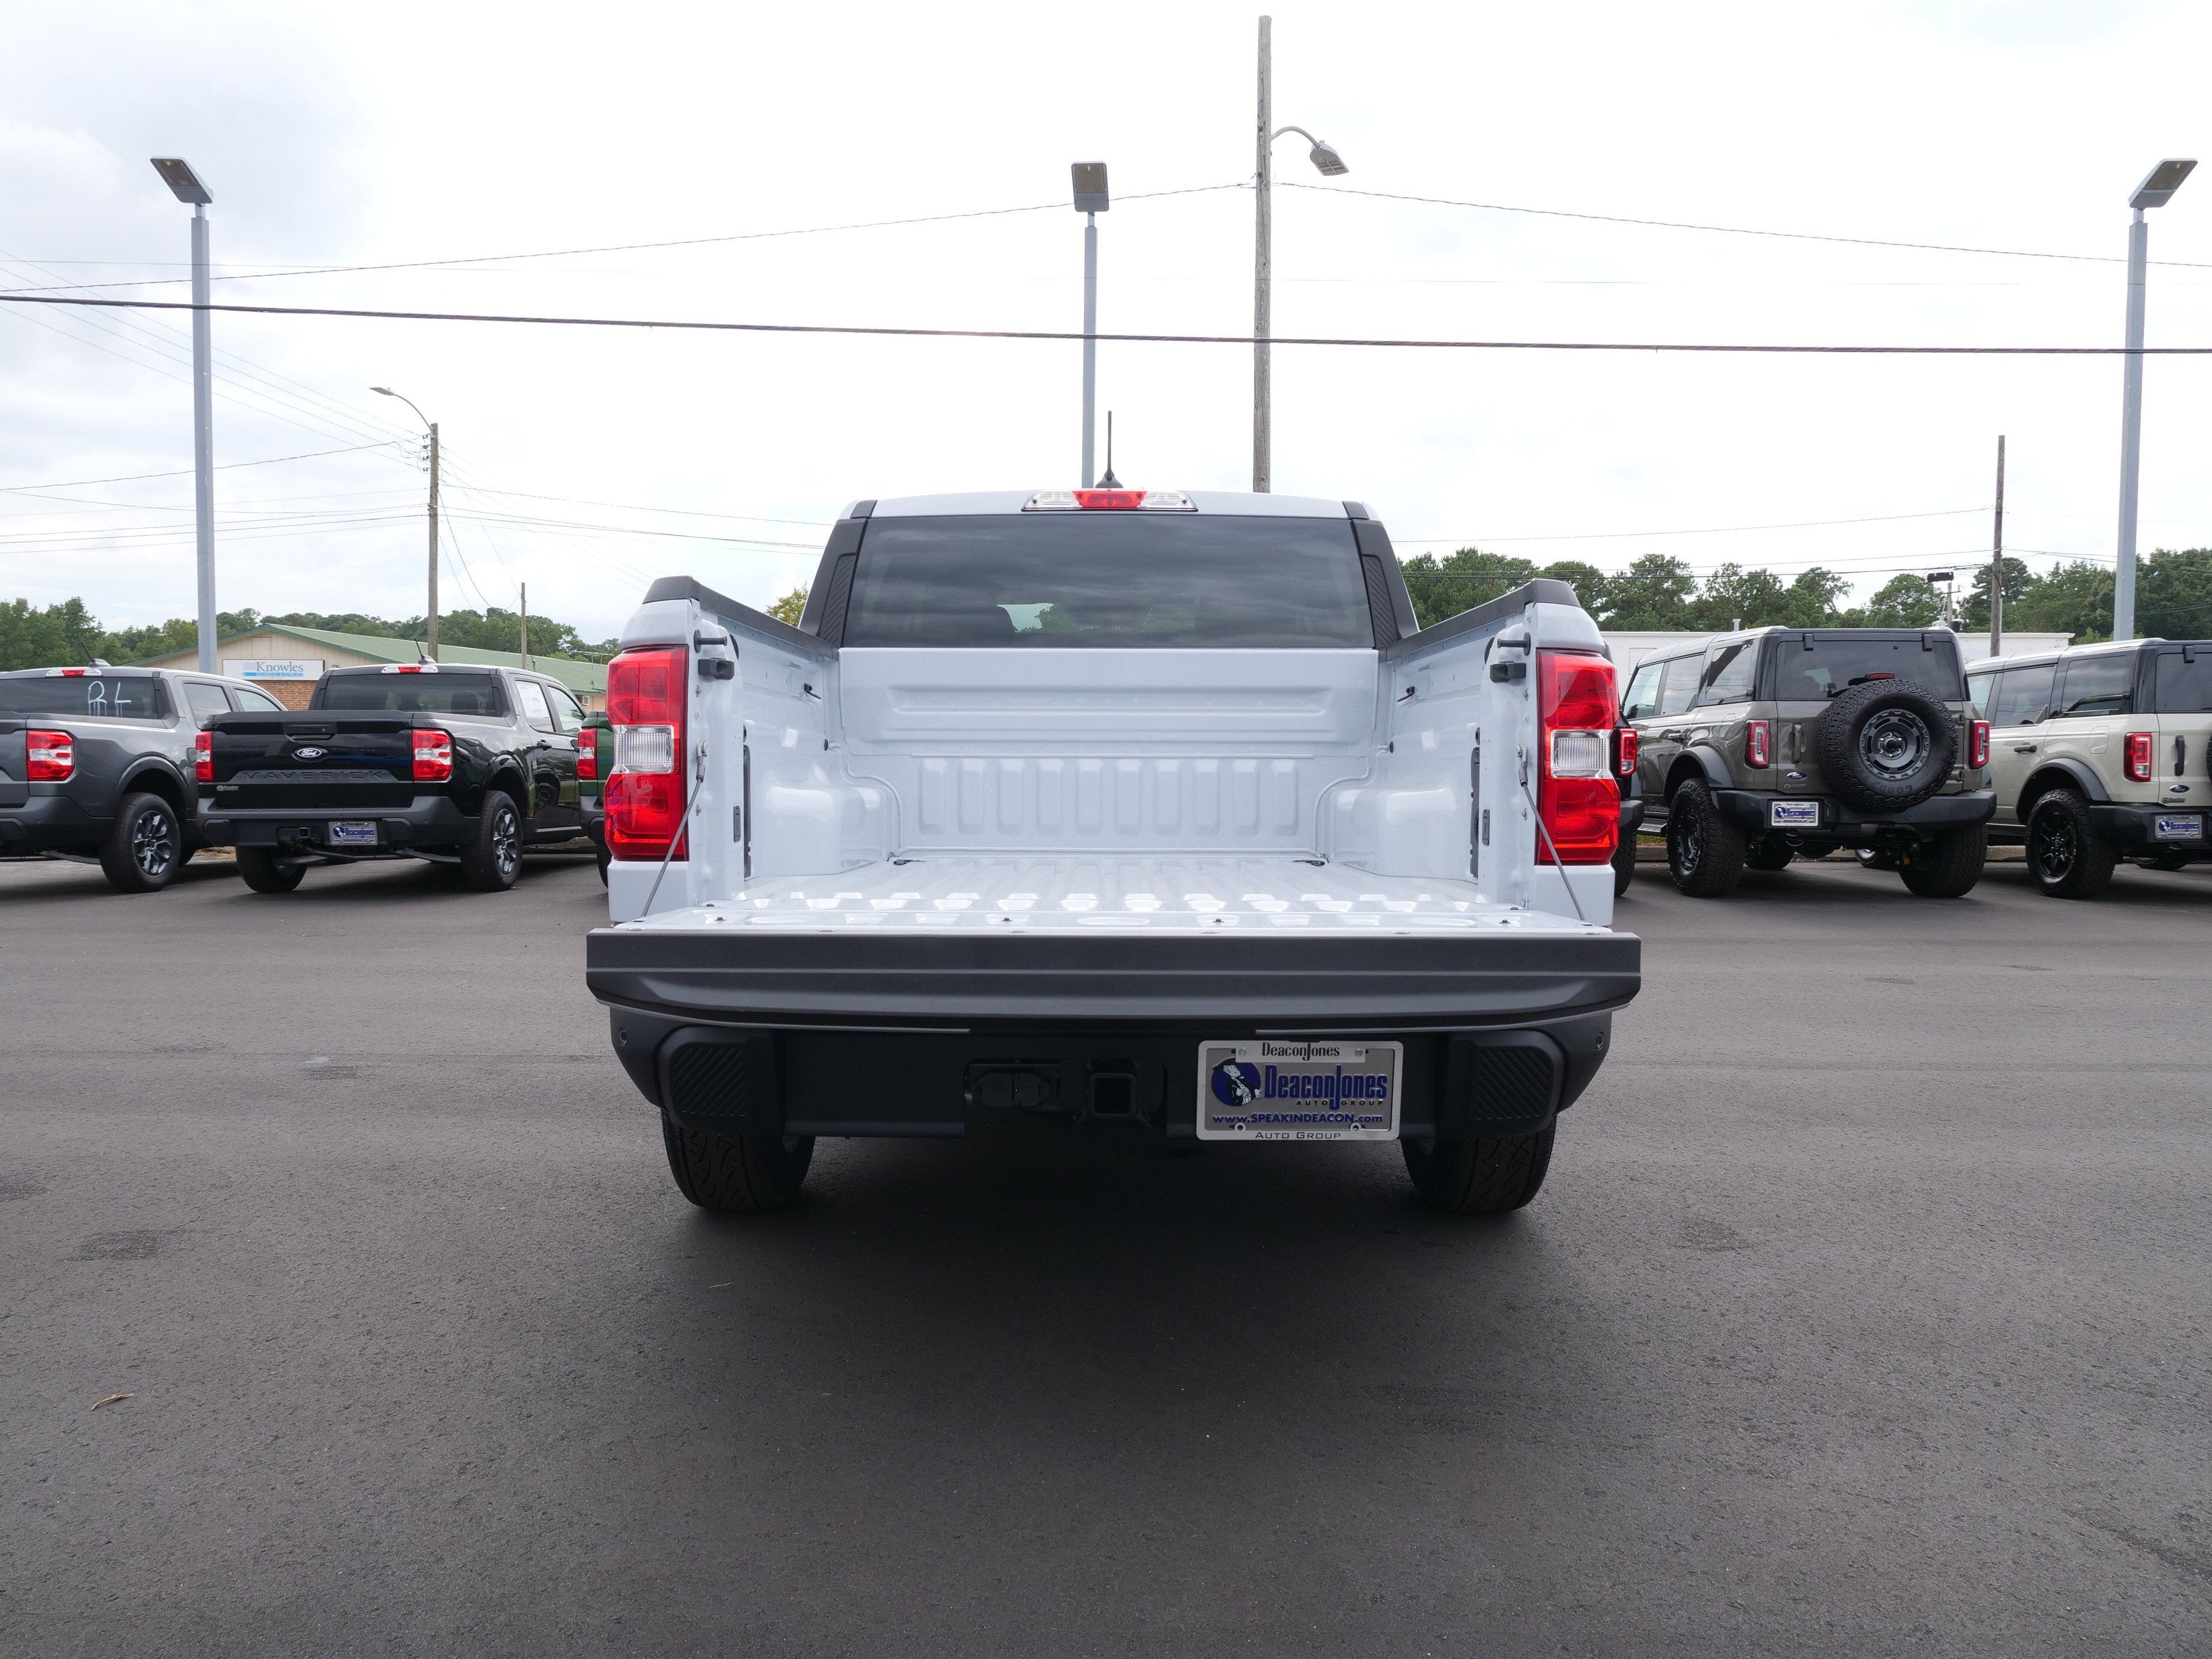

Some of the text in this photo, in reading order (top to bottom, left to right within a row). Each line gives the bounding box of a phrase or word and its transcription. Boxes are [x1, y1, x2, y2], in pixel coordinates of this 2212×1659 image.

[256, 661, 303, 672] Knowles
[243, 771, 384, 780] MAVERICK
[1212, 1113, 1383, 1123] www.SPEAKINDEACON.com
